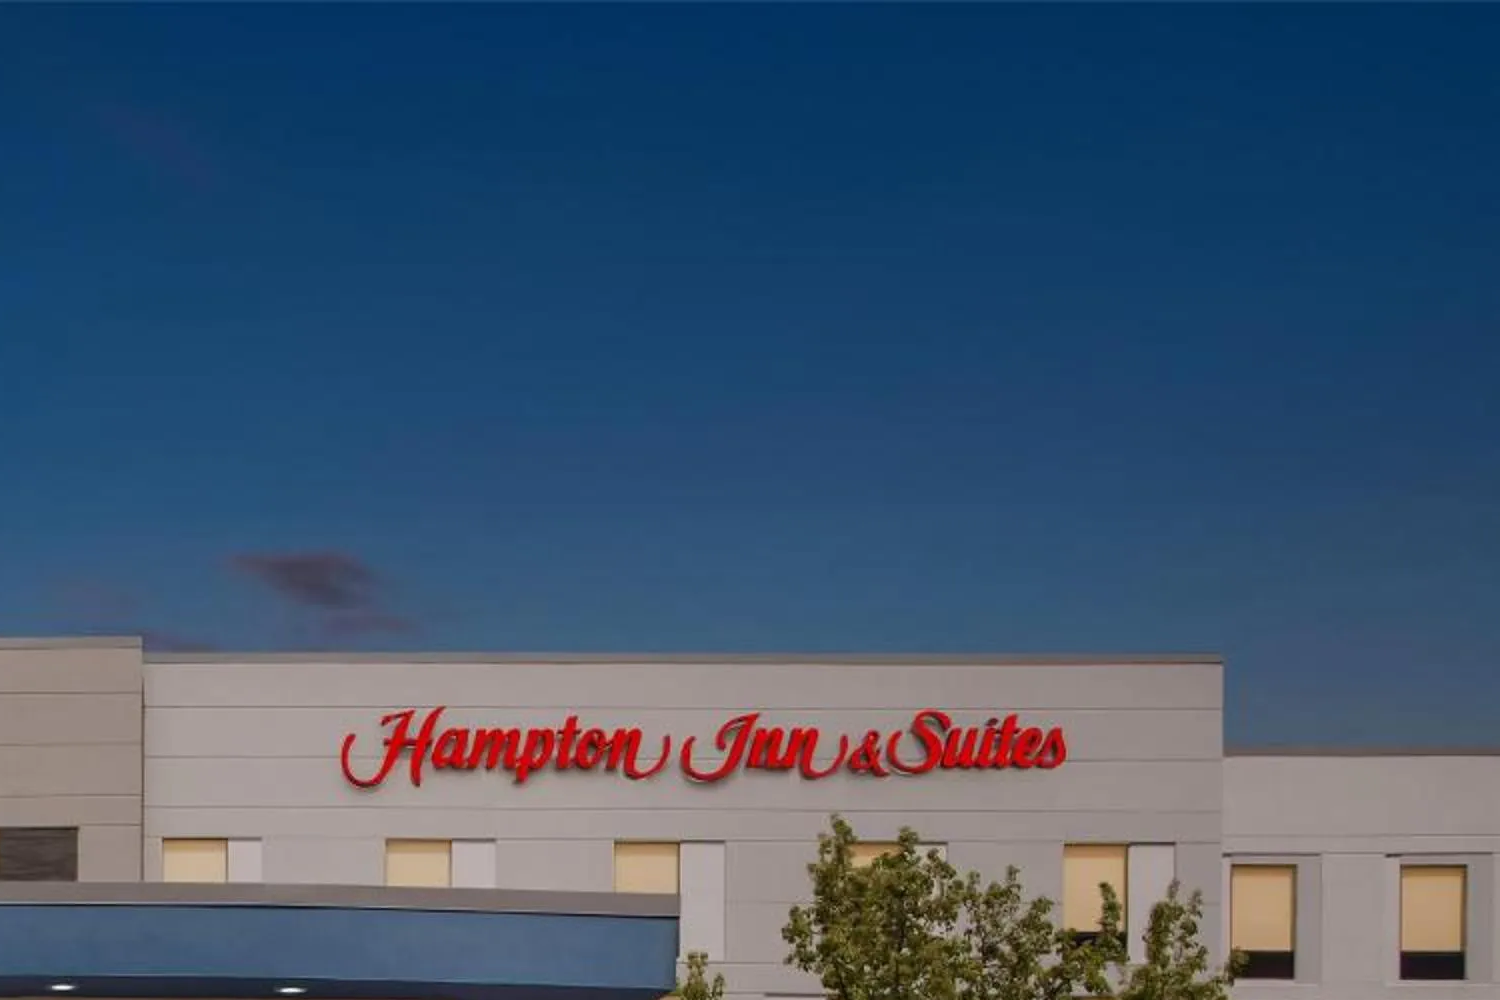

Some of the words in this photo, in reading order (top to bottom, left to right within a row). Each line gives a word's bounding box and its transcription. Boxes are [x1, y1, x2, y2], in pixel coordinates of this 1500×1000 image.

[340, 706, 672, 787] Hampton
[681, 712, 849, 782] Inn
[887, 708, 1068, 774] Suites
